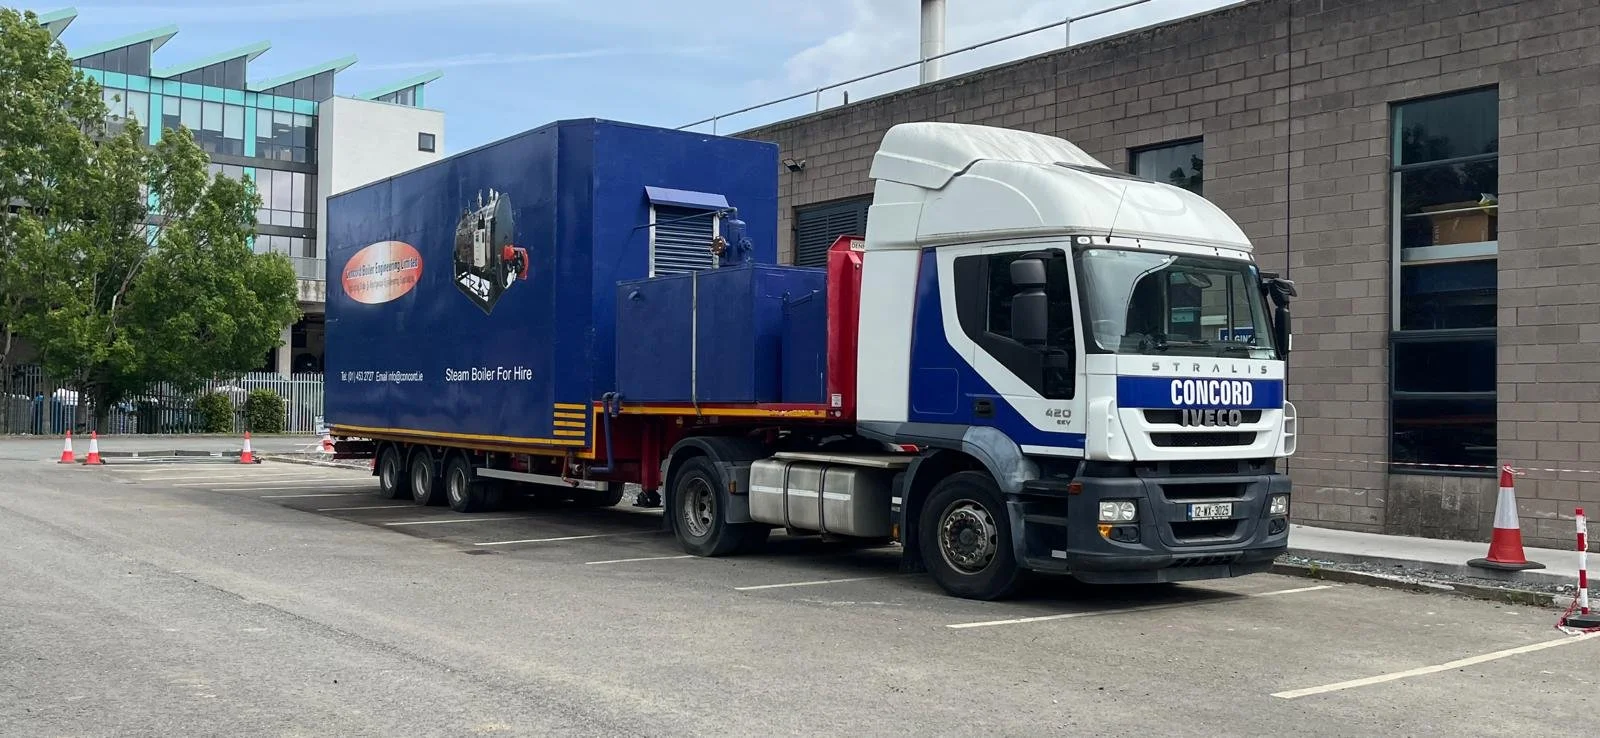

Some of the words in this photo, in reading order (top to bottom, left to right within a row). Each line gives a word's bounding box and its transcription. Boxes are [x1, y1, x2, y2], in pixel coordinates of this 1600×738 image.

[362, 264, 375, 277] Boiler
[375, 261, 401, 276] Engineering
[401, 256, 418, 271] Limited
[364, 371, 375, 381] 2727
[445, 368, 470, 381] Steam
[471, 367, 496, 381] Boiler
[497, 366, 512, 381] For
[513, 365, 532, 380] Hire
[1151, 362, 1268, 375] STRALIS
[1170, 379, 1253, 406] CONCORD
[1045, 408, 1072, 418] 420
[1181, 409, 1242, 427] IVECO
[1194, 503, 1230, 517] 12-WX-3025
